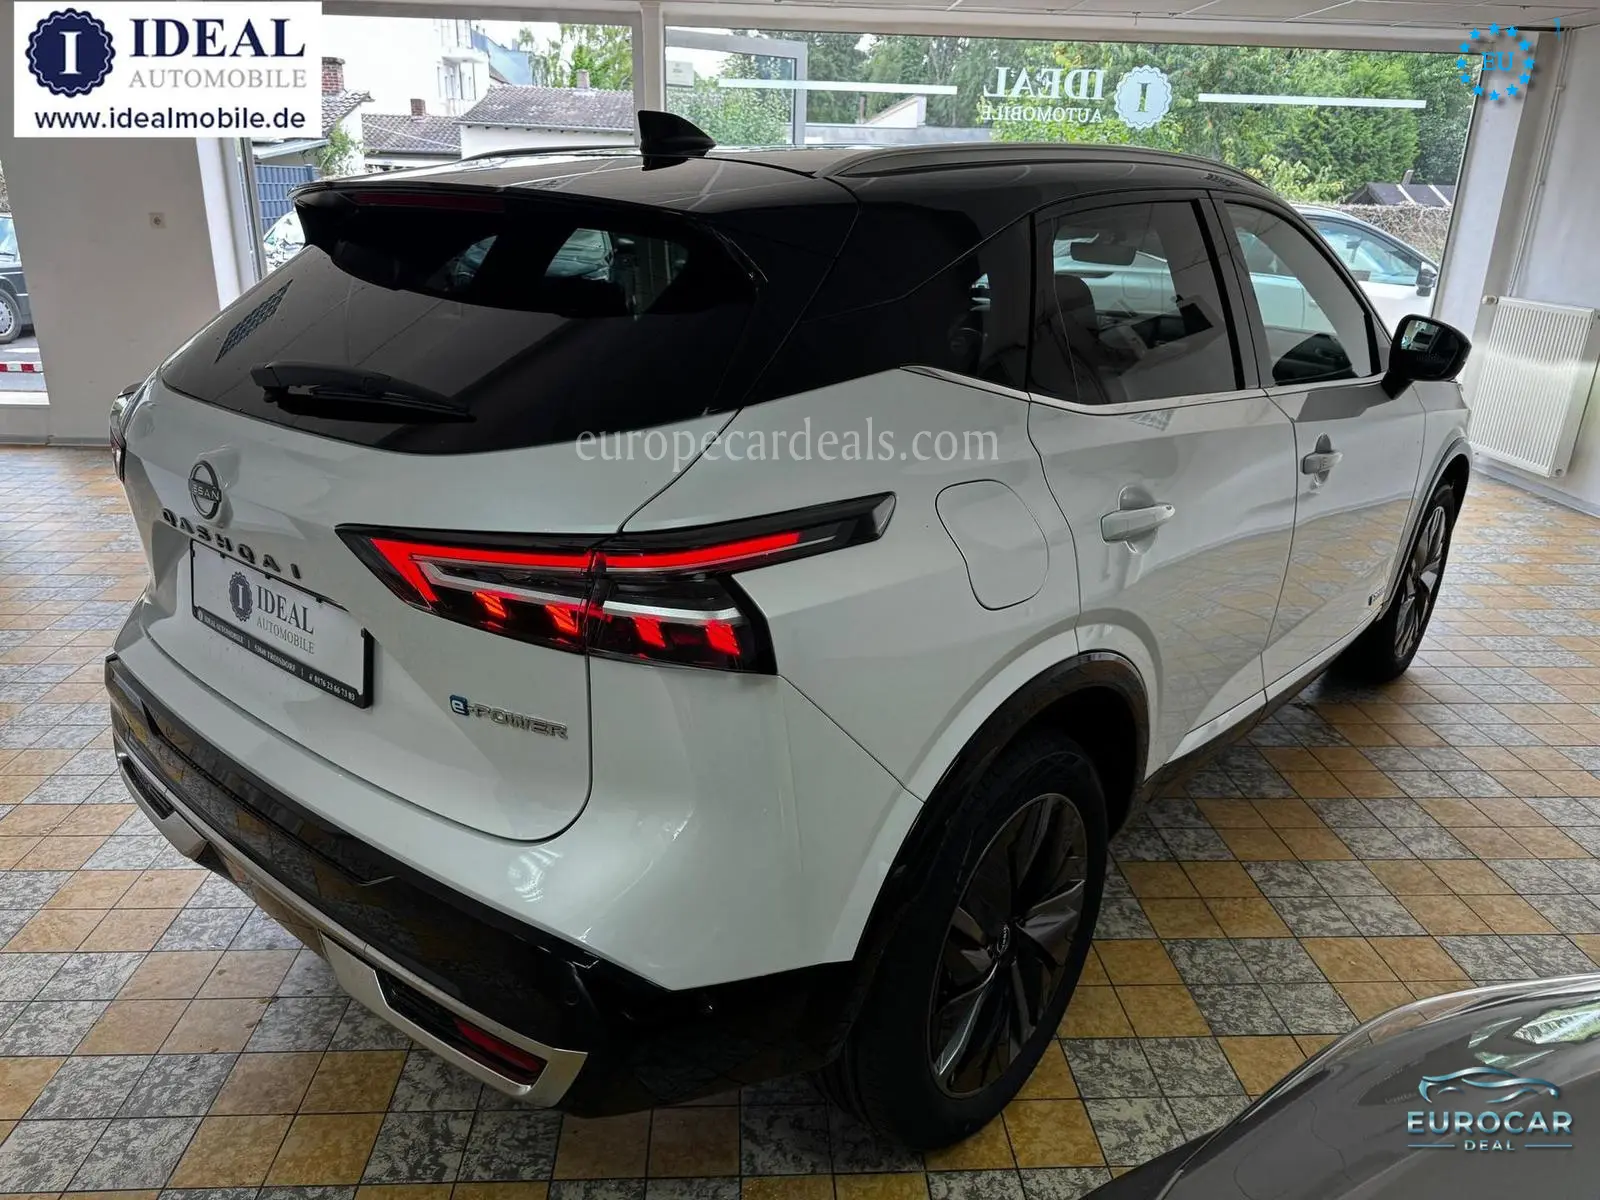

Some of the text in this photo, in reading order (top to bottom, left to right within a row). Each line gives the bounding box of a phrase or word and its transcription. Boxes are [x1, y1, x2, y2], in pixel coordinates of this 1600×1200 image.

[163, 508, 301, 579] QASHQAI
[256, 584, 314, 634] IDEAL
[257, 616, 315, 655] AUTOMOBILE
[449, 695, 568, 740] e-POWER
